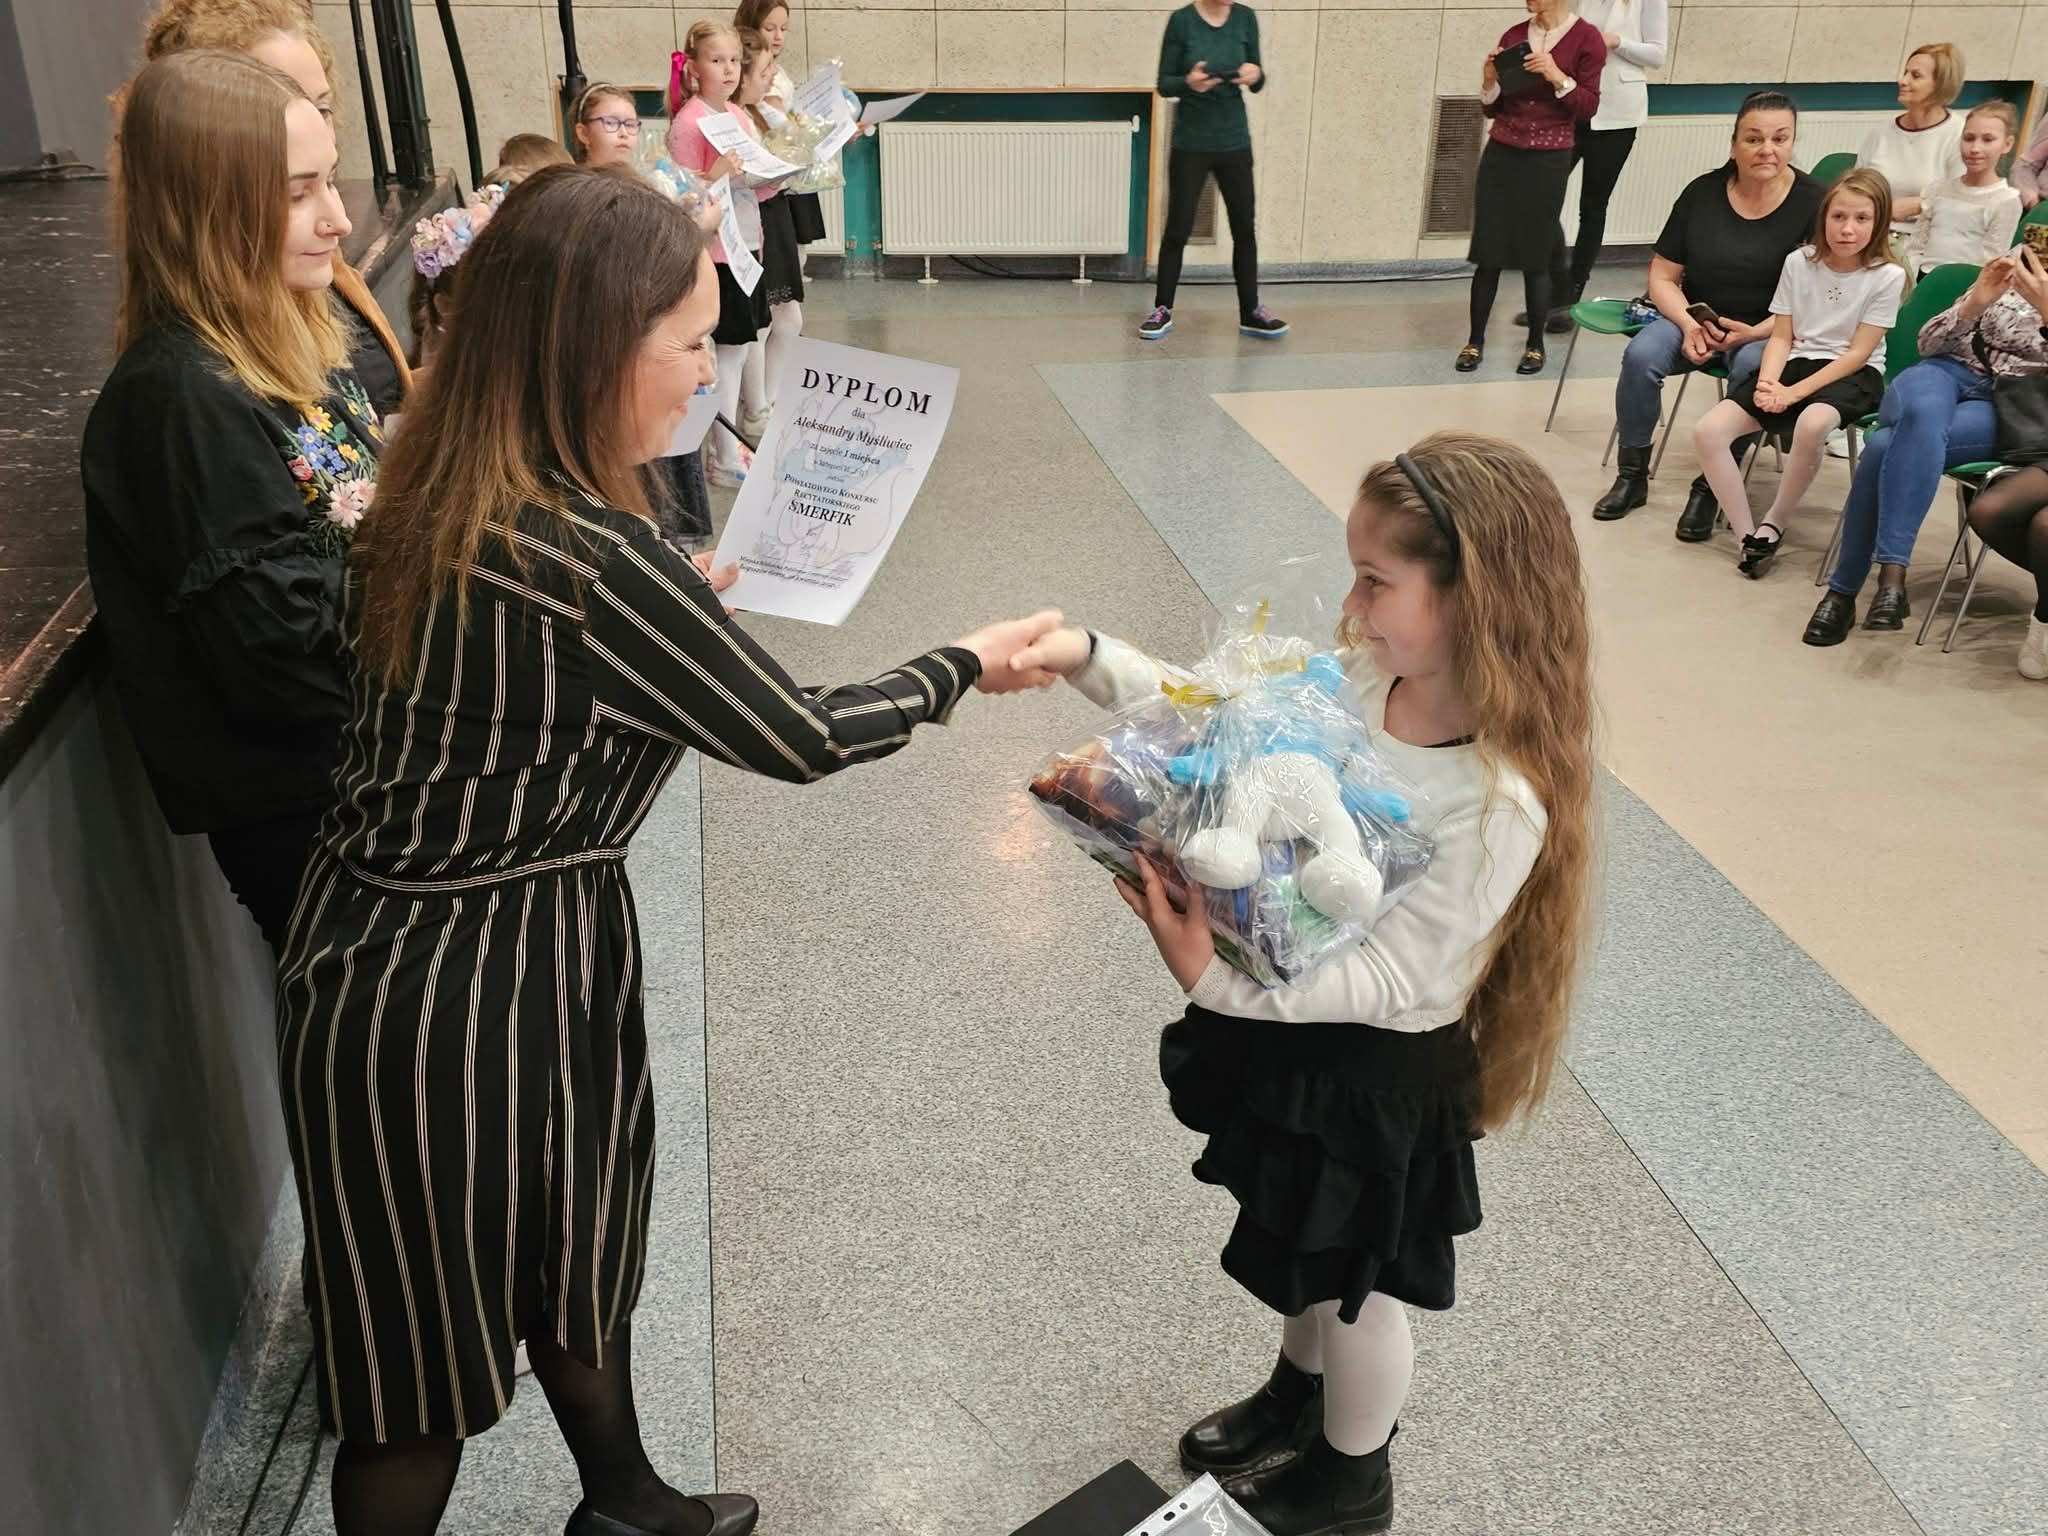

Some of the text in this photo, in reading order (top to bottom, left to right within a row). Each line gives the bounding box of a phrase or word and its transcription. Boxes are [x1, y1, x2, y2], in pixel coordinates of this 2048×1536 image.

[801, 368, 932, 415] DYPLOM
[851, 407, 866, 420] dla
[793, 416, 913, 451] Aleksandry Myśliwiec
[849, 452, 881, 466] miejsca
[788, 499, 856, 526] SMERFIK
